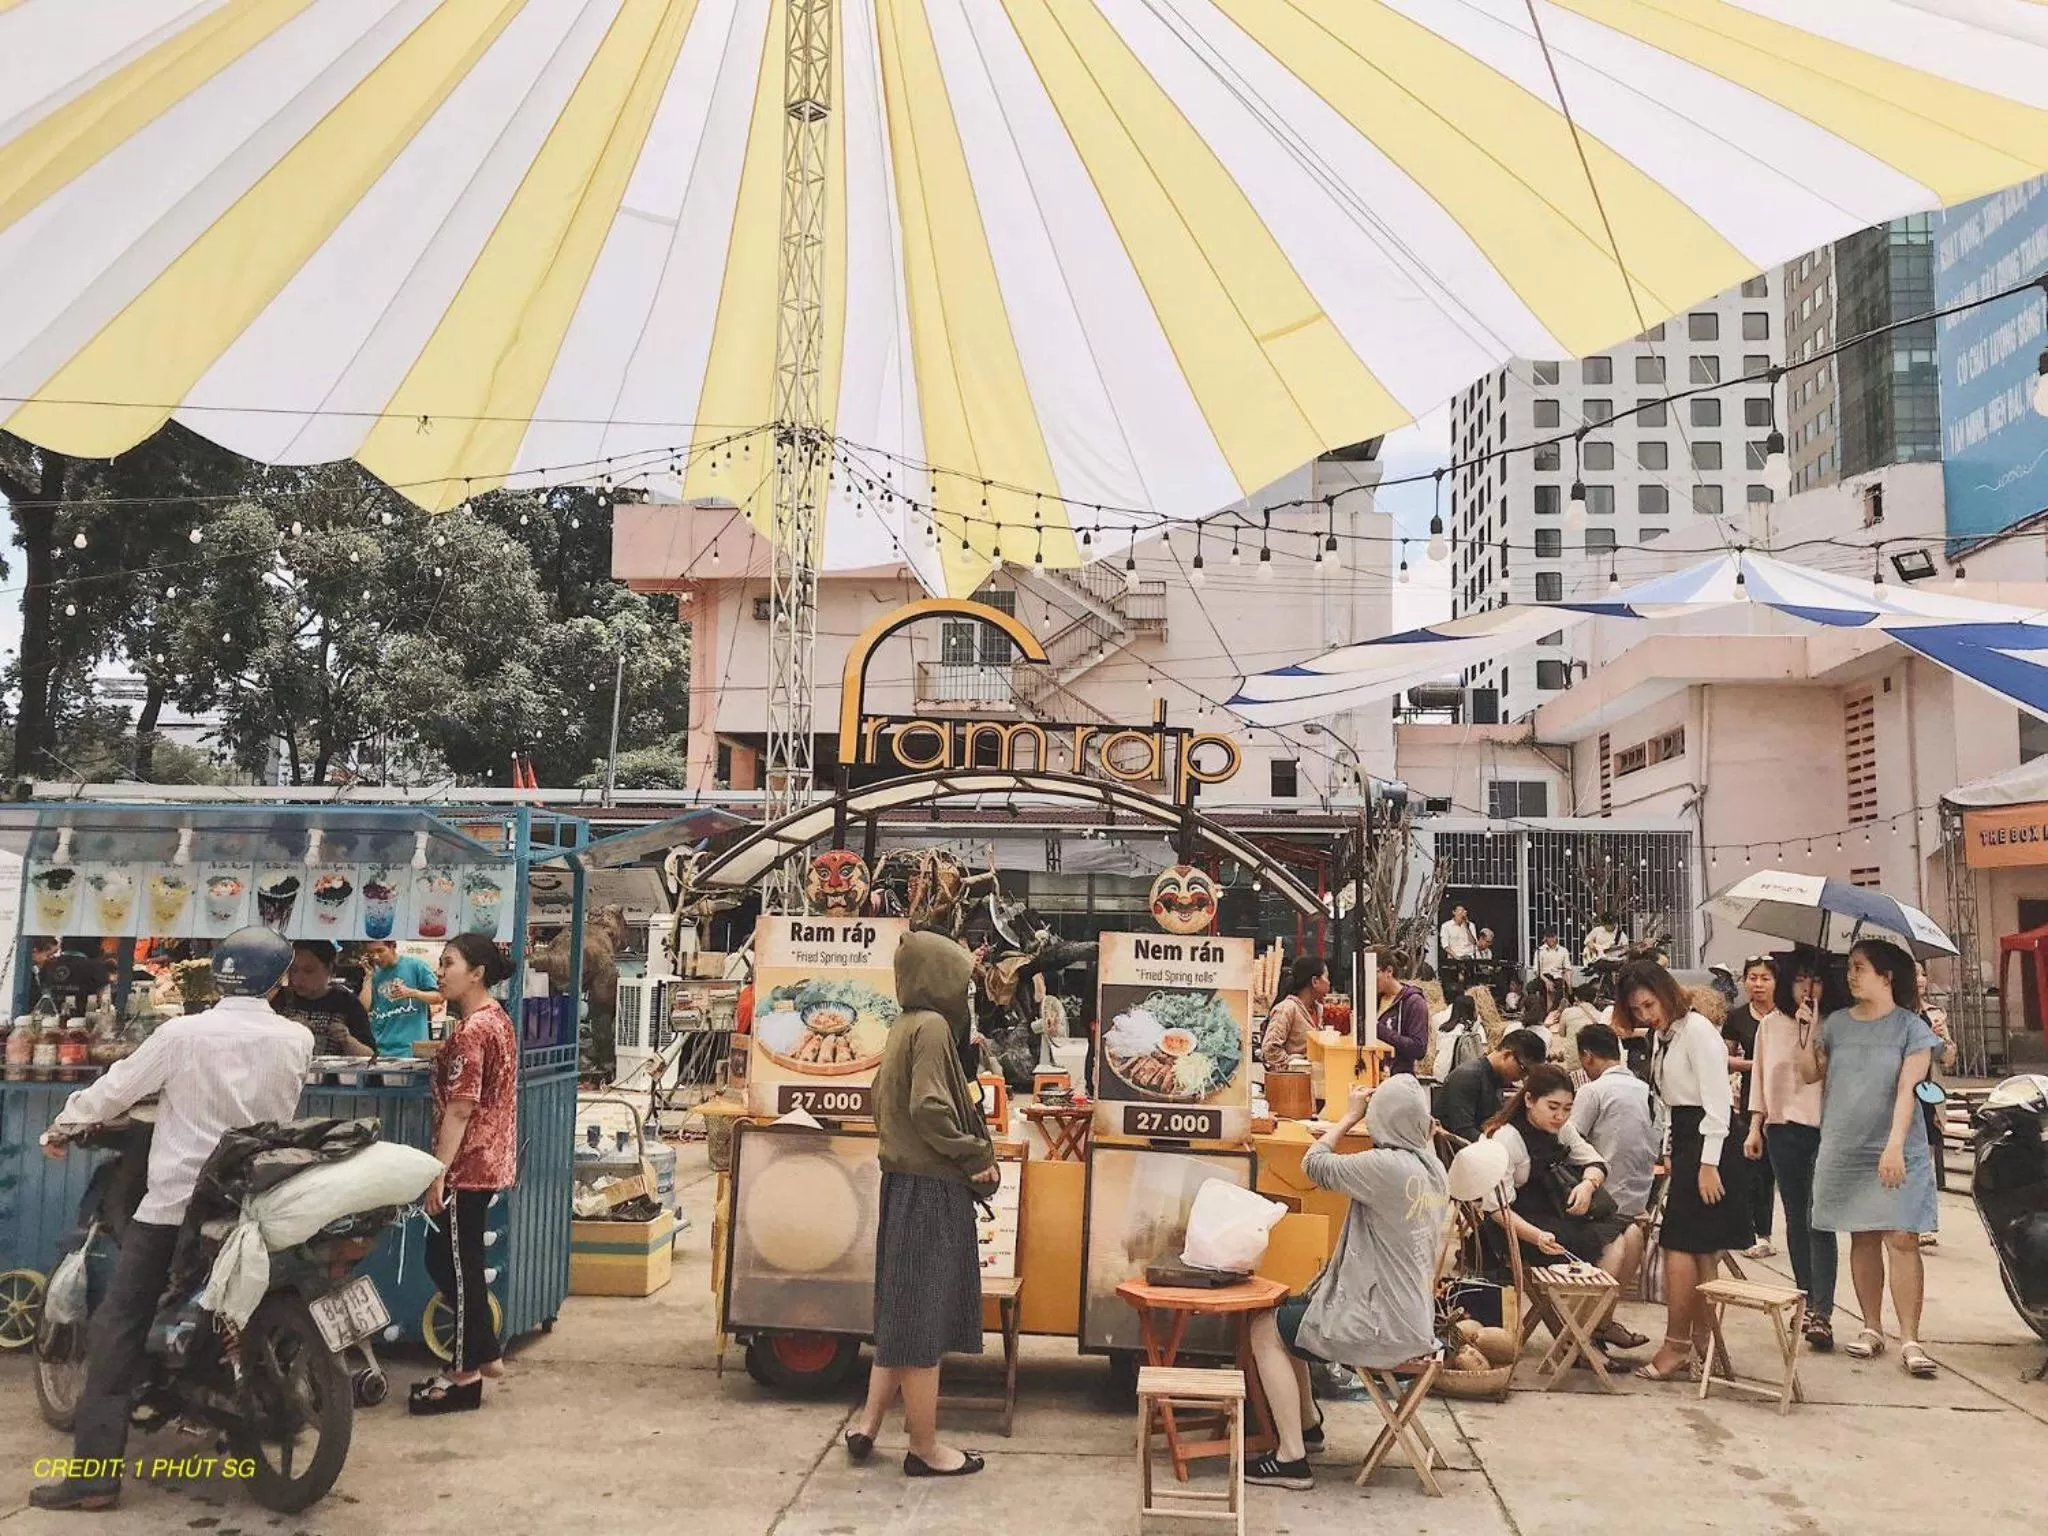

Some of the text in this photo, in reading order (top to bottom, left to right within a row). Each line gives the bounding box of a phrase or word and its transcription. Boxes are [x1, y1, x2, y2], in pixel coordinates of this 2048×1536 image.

[1980, 829, 2006, 847] THE
[2010, 825, 2039, 844] BOX
[791, 922, 876, 948] Ram ráp
[820, 952, 847, 966] Spring
[1134, 939, 1225, 963] Nem rán
[1165, 969, 1193, 984] Spring
[791, 1092, 862, 1111] 27.000
[1137, 1112, 1210, 1133] 27.000
